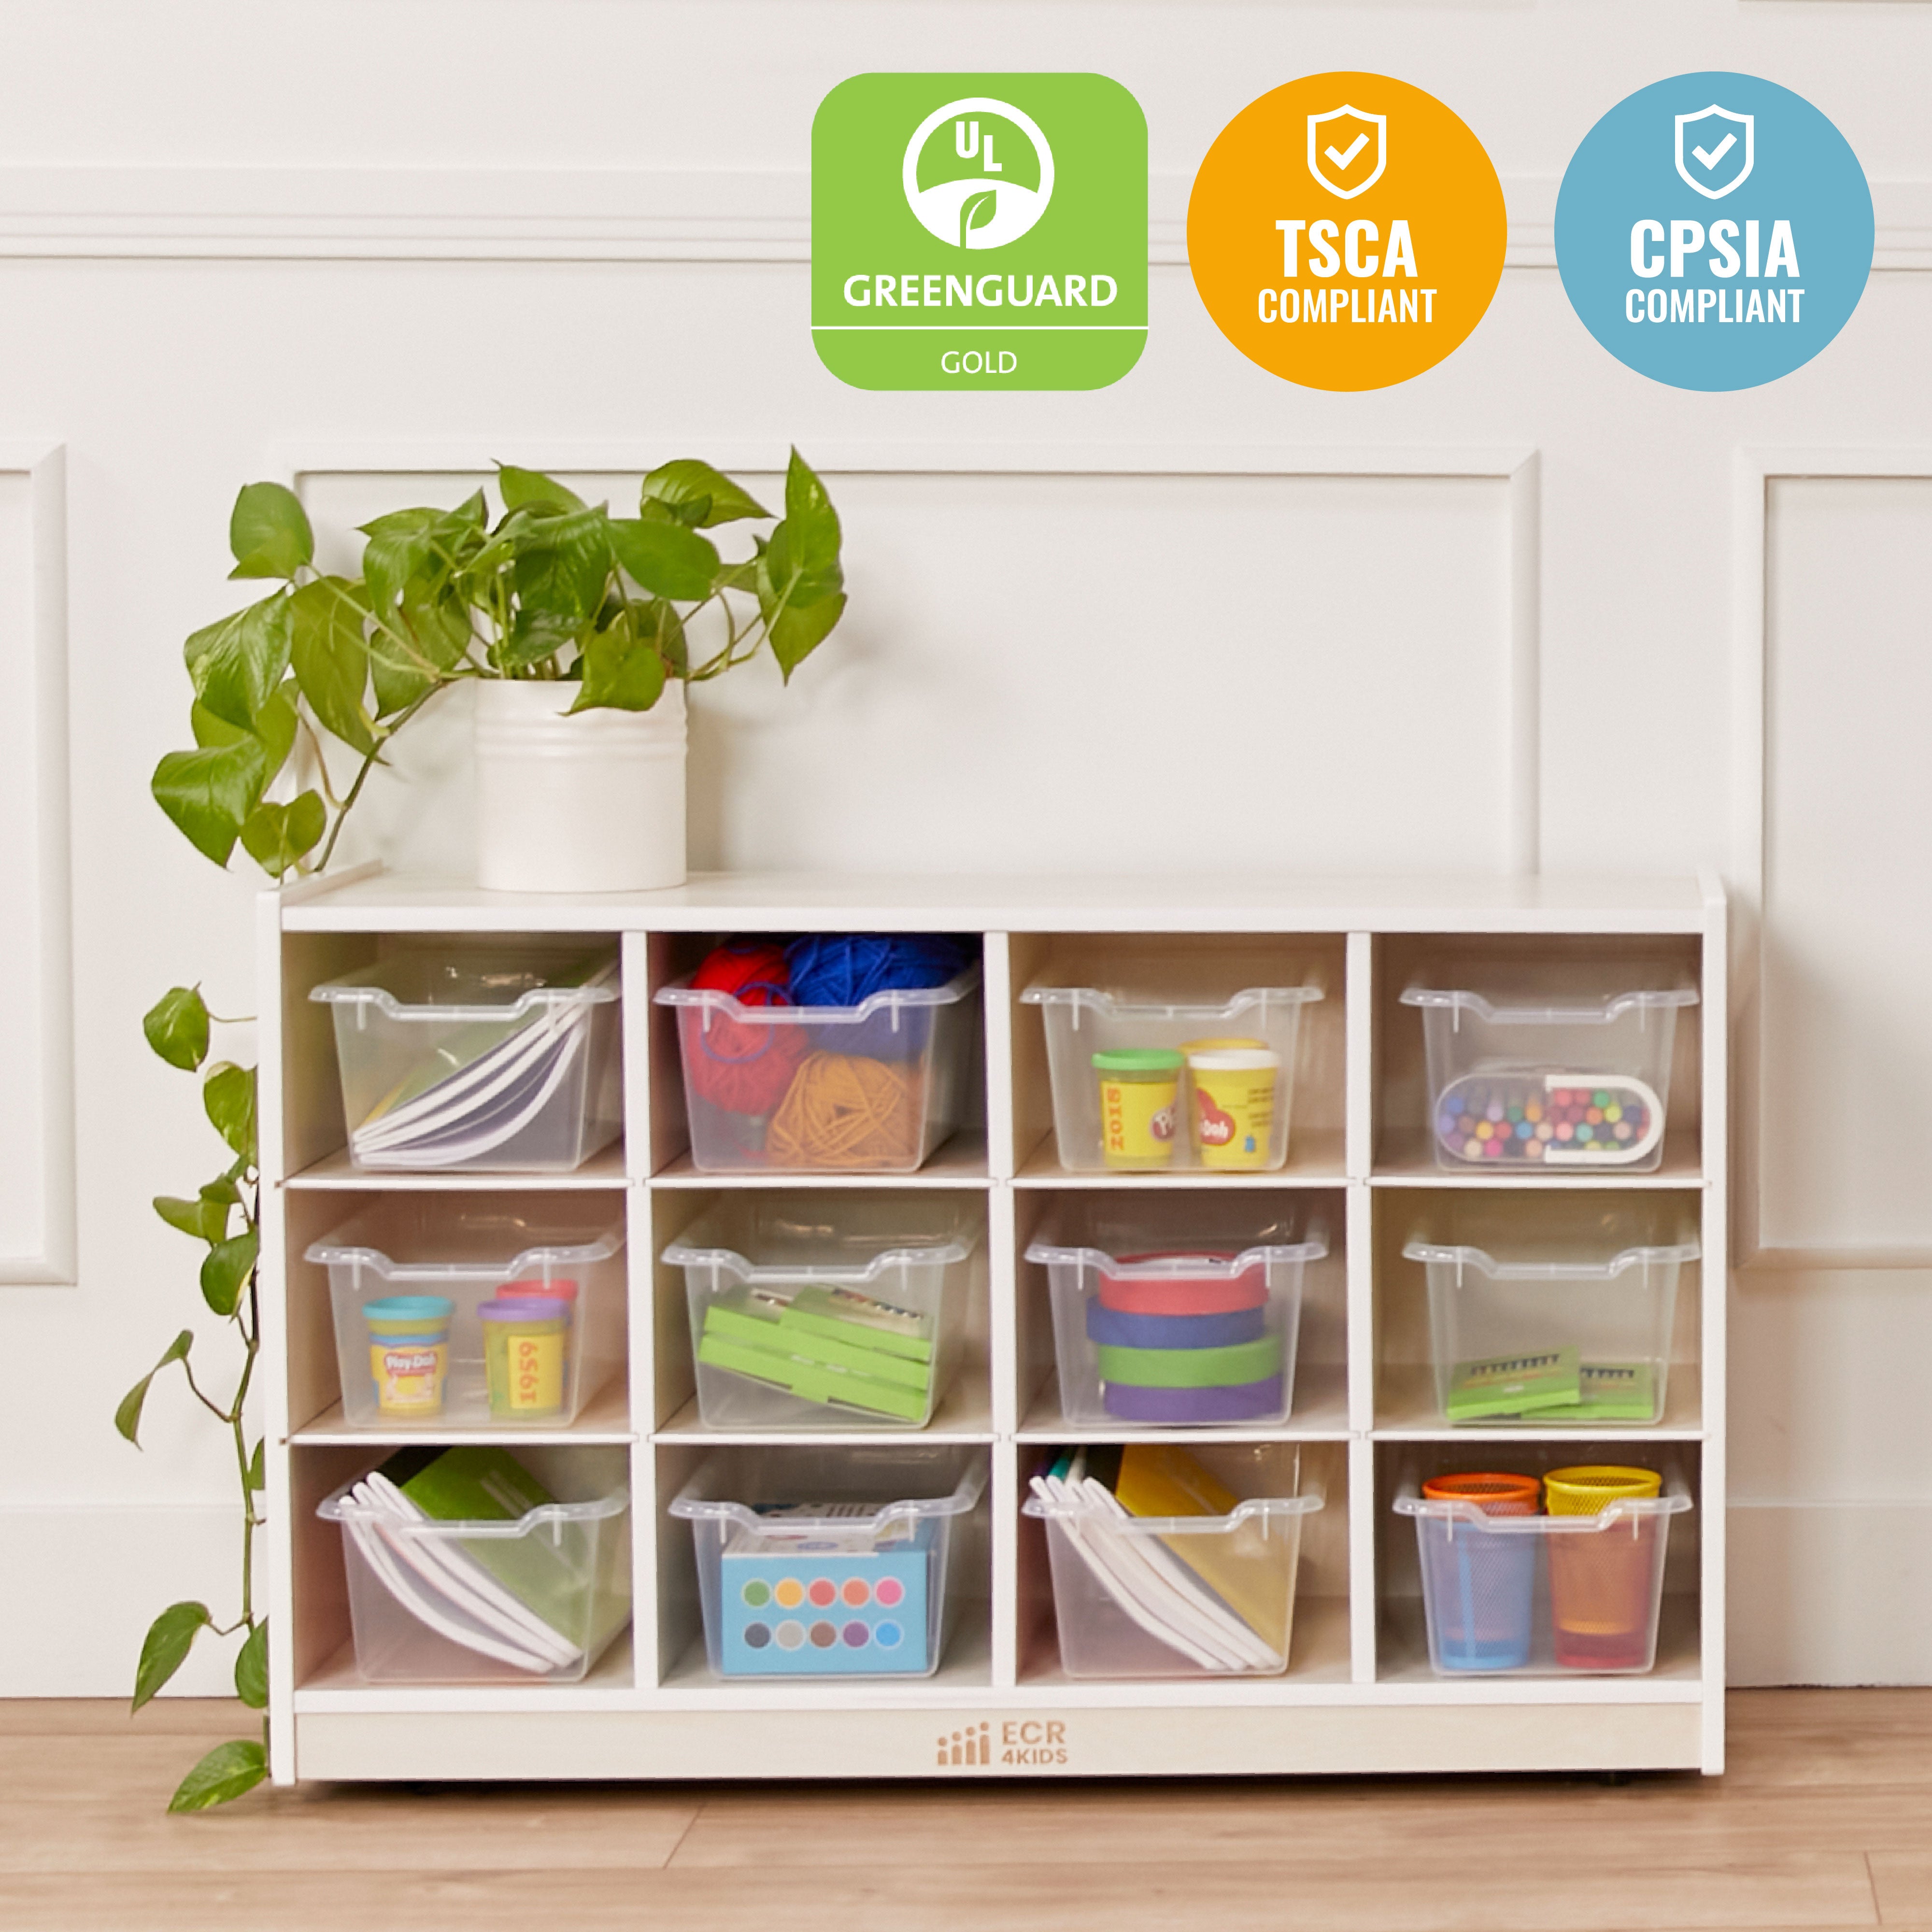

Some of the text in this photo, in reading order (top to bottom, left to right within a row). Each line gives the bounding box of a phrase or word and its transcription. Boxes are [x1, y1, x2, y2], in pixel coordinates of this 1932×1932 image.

[519, 1341, 539, 1404] 1959
[1002, 1720, 1065, 1745] ECR
[1001, 1748, 1067, 1764] 4KIDS
